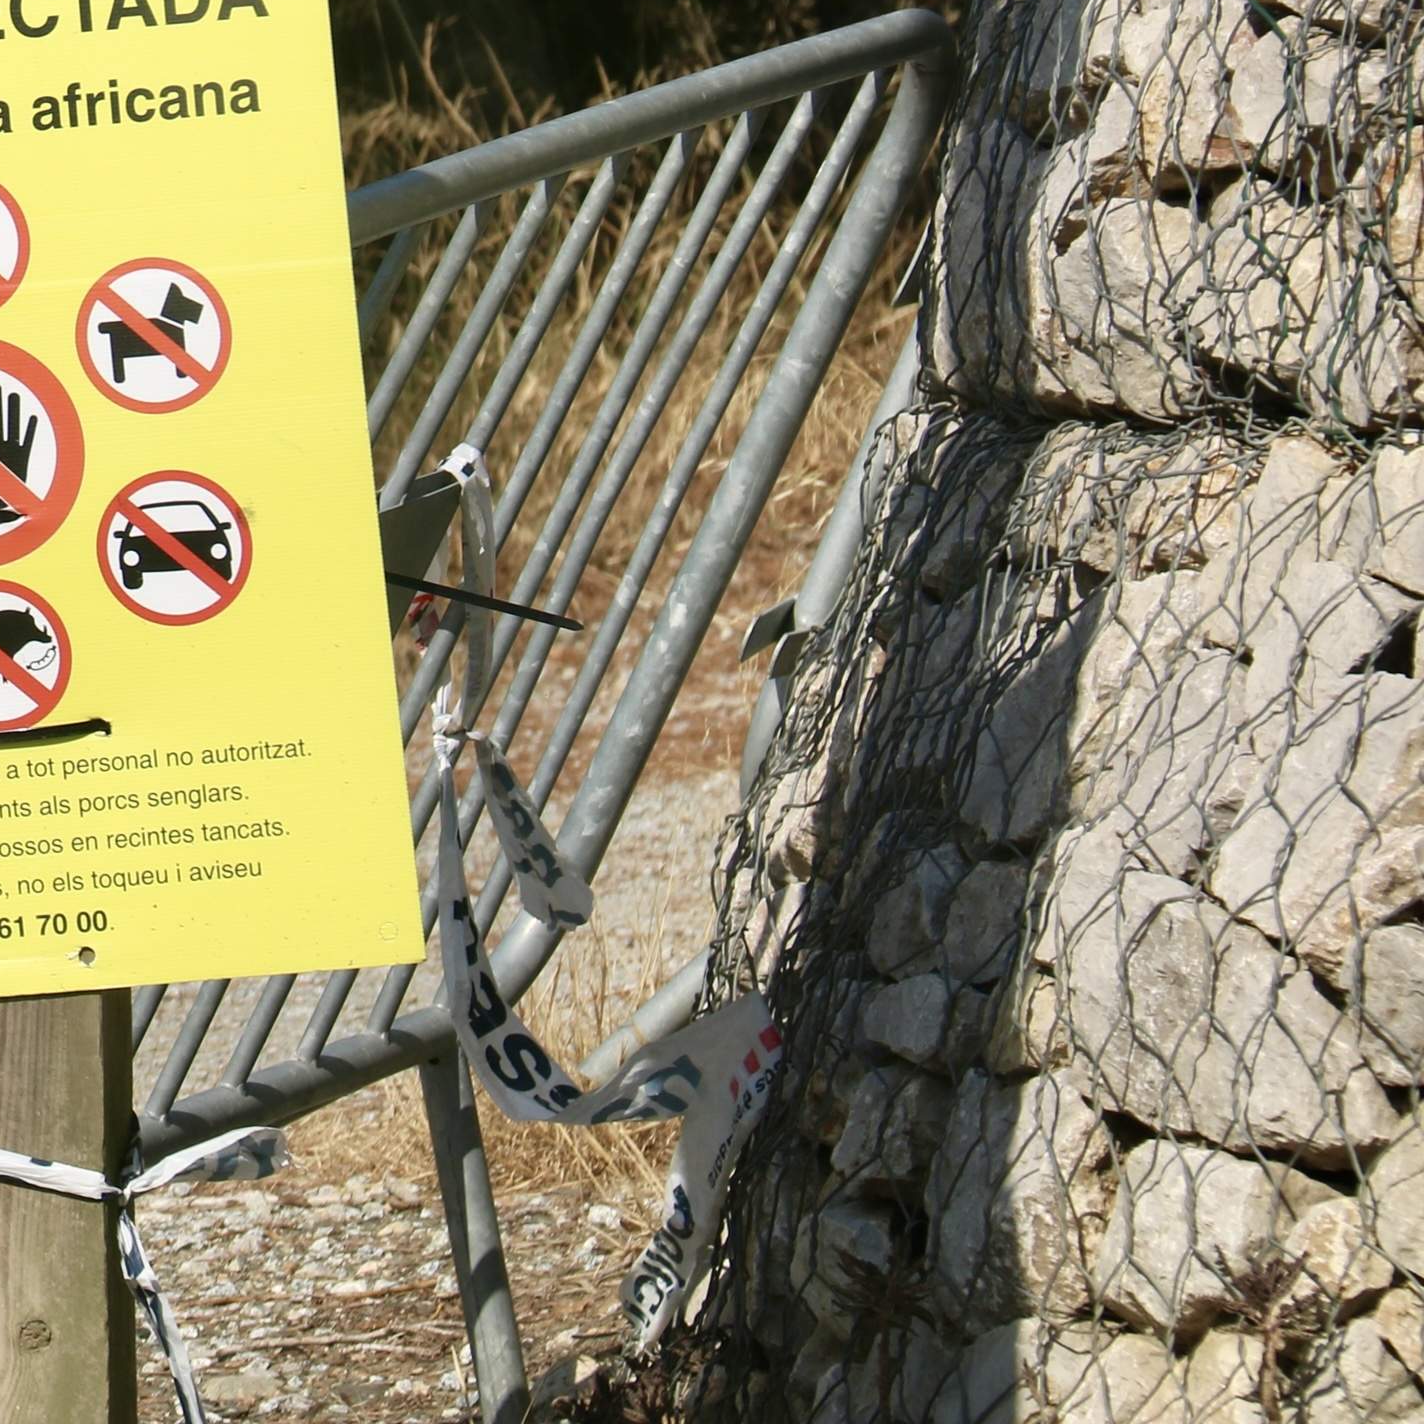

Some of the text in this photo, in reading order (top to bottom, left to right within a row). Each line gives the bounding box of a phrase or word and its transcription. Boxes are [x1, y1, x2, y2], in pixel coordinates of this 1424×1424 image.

[33, 79, 260, 130] africana
[7, 765, 19, 779] a
[27, 758, 55, 777] tot
[63, 749, 158, 780] personal
[167, 751, 193, 766] no
[202, 739, 311, 764] autoritzat.
[40, 796, 70, 815] als
[79, 794, 139, 817] porcs
[148, 784, 248, 809] senglars.
[72, 836, 98, 851] en
[107, 827, 194, 848] recintes
[201, 819, 289, 841] tancats.
[18, 879, 44, 894] no
[53, 872, 84, 891] els
[91, 870, 168, 891] toqueu
[177, 864, 181, 882] i
[190, 861, 261, 881] aviseu
[36, 913, 67, 935] 70
